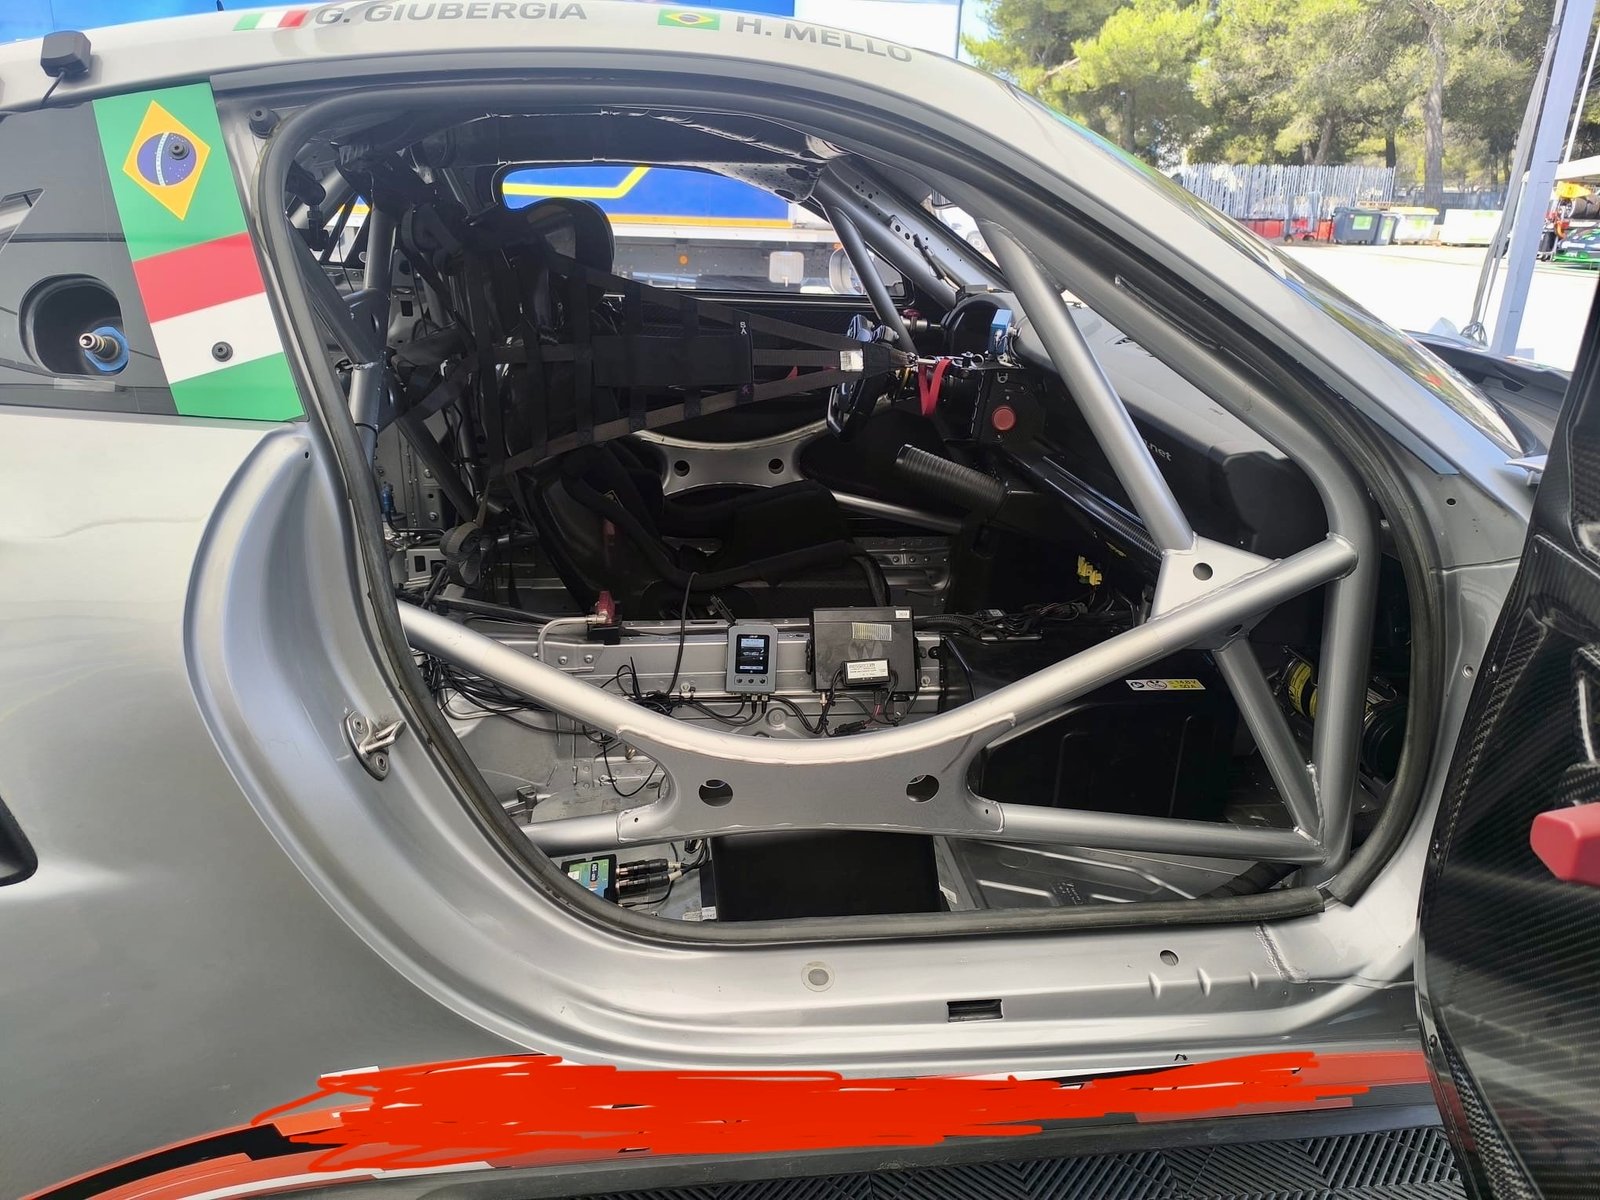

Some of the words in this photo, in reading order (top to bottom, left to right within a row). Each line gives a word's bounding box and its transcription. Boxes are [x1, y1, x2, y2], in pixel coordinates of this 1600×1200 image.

[315, 7, 351, 25] G.
[364, 2, 588, 22] GIUBERGIA
[736, 16, 772, 36] H.
[784, 23, 913, 63] MELLO
